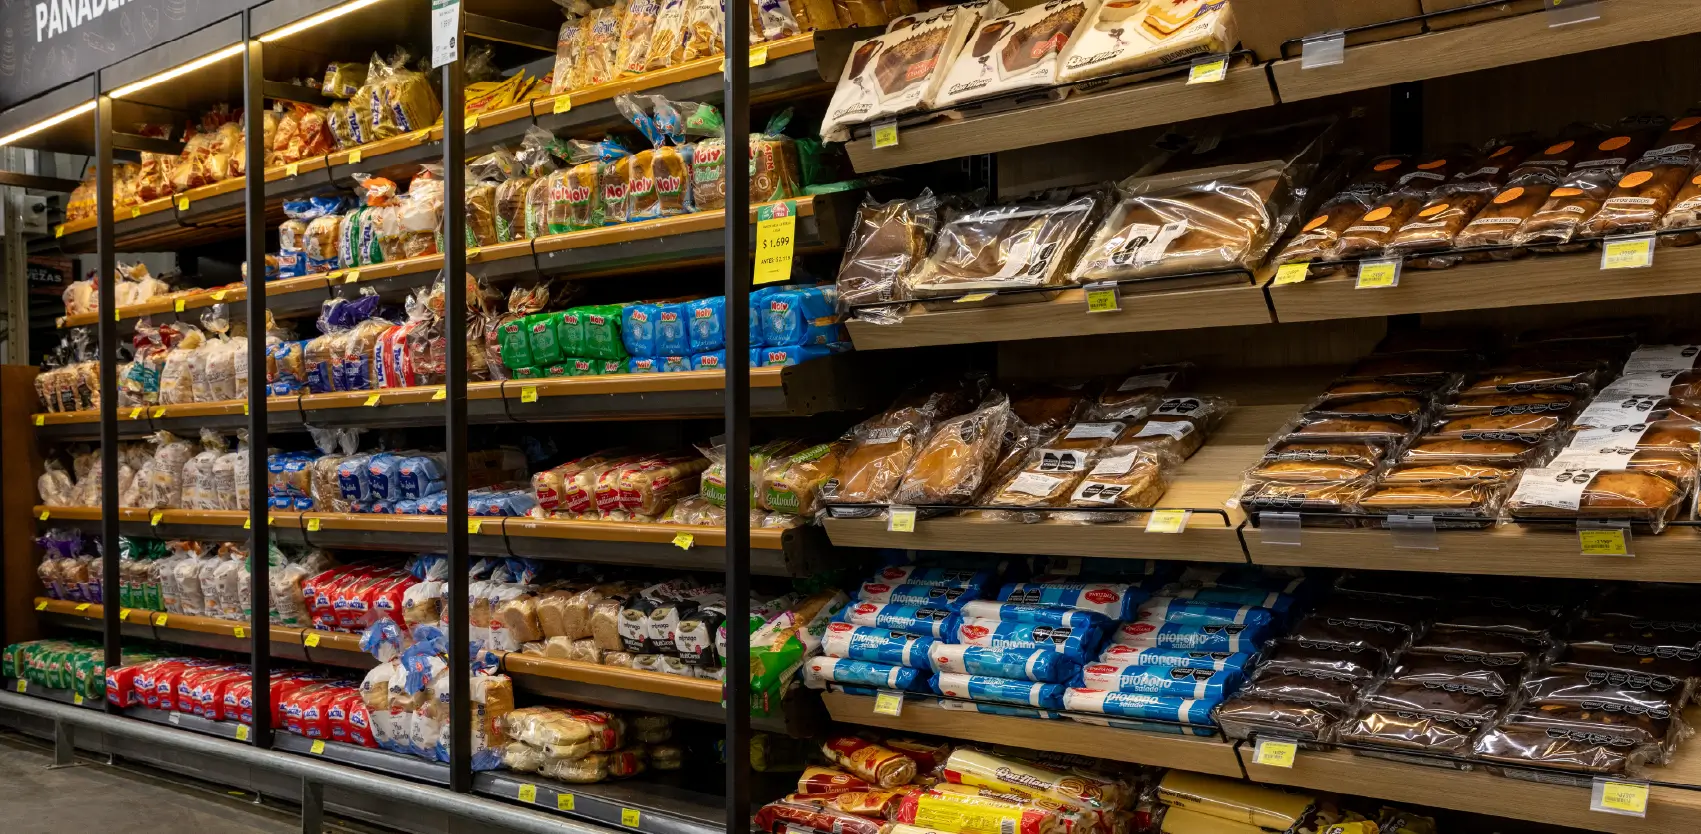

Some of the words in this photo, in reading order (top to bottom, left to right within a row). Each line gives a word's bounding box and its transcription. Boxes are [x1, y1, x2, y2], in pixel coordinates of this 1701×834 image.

[606, 185, 628, 199] Nol
[770, 236, 790, 248] 1.699
[766, 493, 799, 508] Salvado
[891, 592, 930, 606] pionono
[877, 612, 915, 627] pionono
[1158, 630, 1206, 645] pionono
[1120, 672, 1172, 688] pionono
